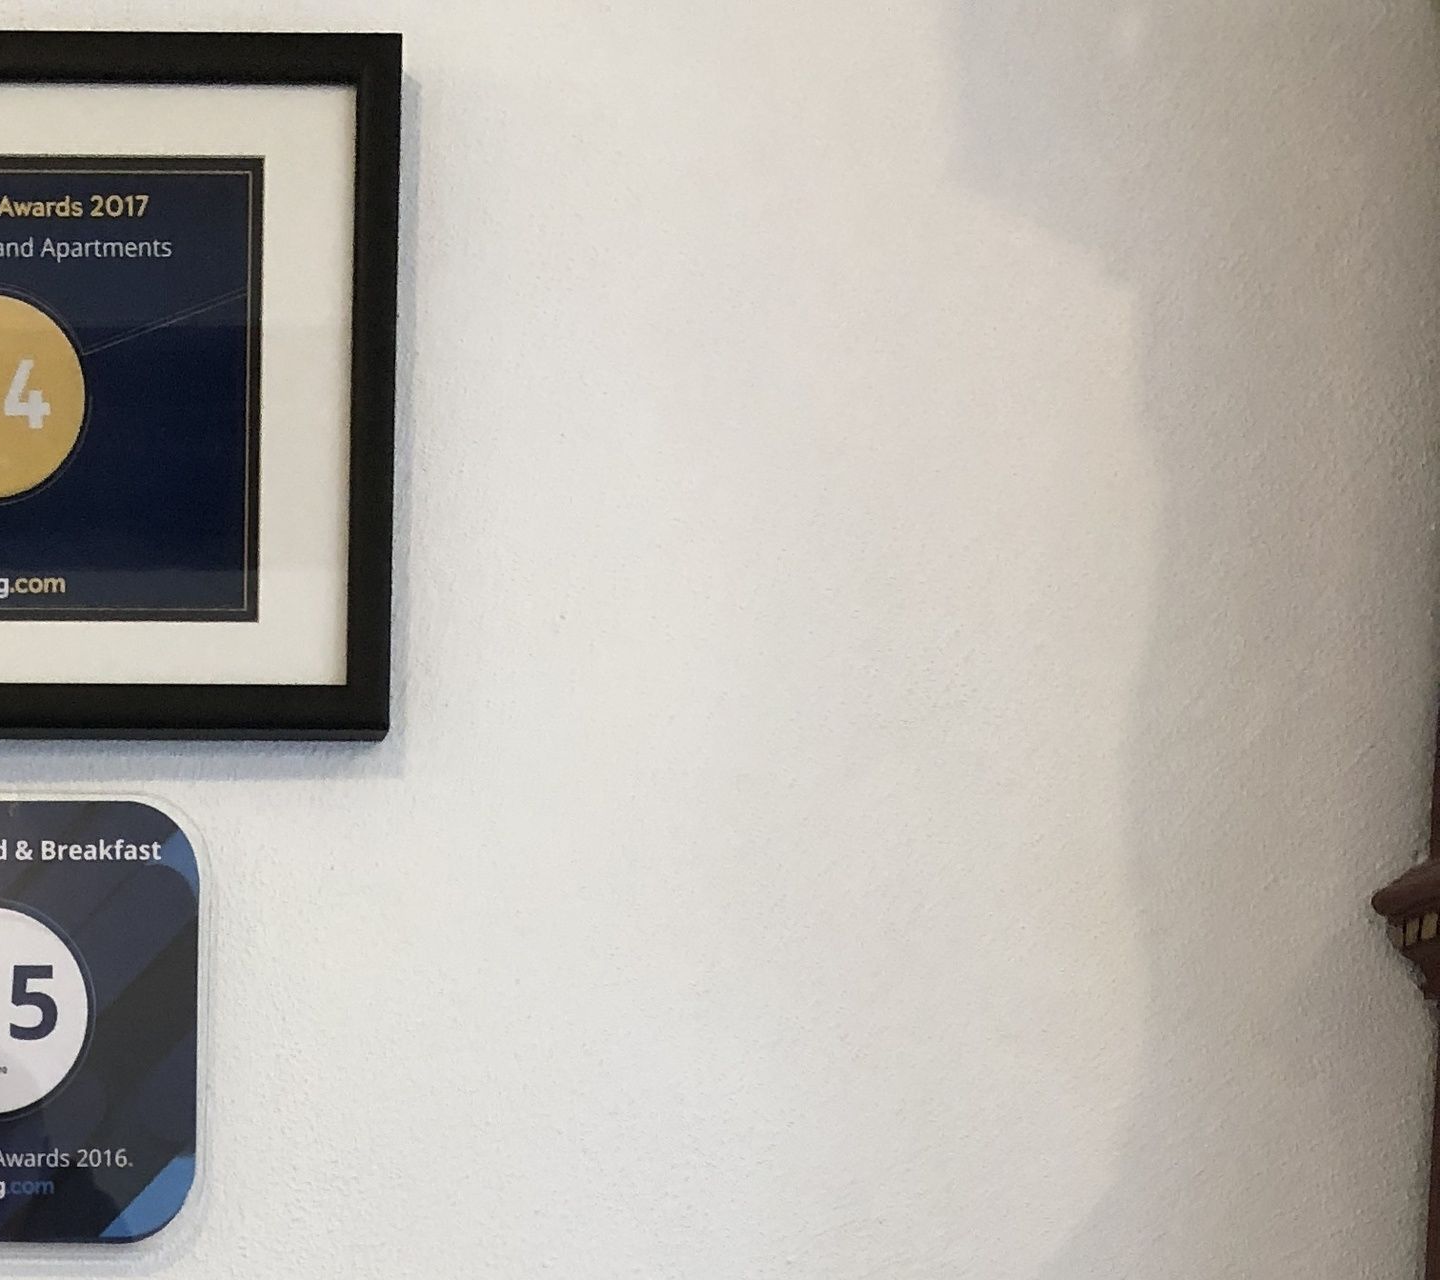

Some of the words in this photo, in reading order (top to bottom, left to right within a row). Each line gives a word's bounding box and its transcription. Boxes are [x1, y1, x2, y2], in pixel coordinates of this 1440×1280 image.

[90, 195, 149, 217] 2017
[41, 237, 172, 264] Apartments
[15, 841, 34, 860] &
[41, 839, 161, 861] Breakfast
[77, 1149, 134, 1168] 2016.
